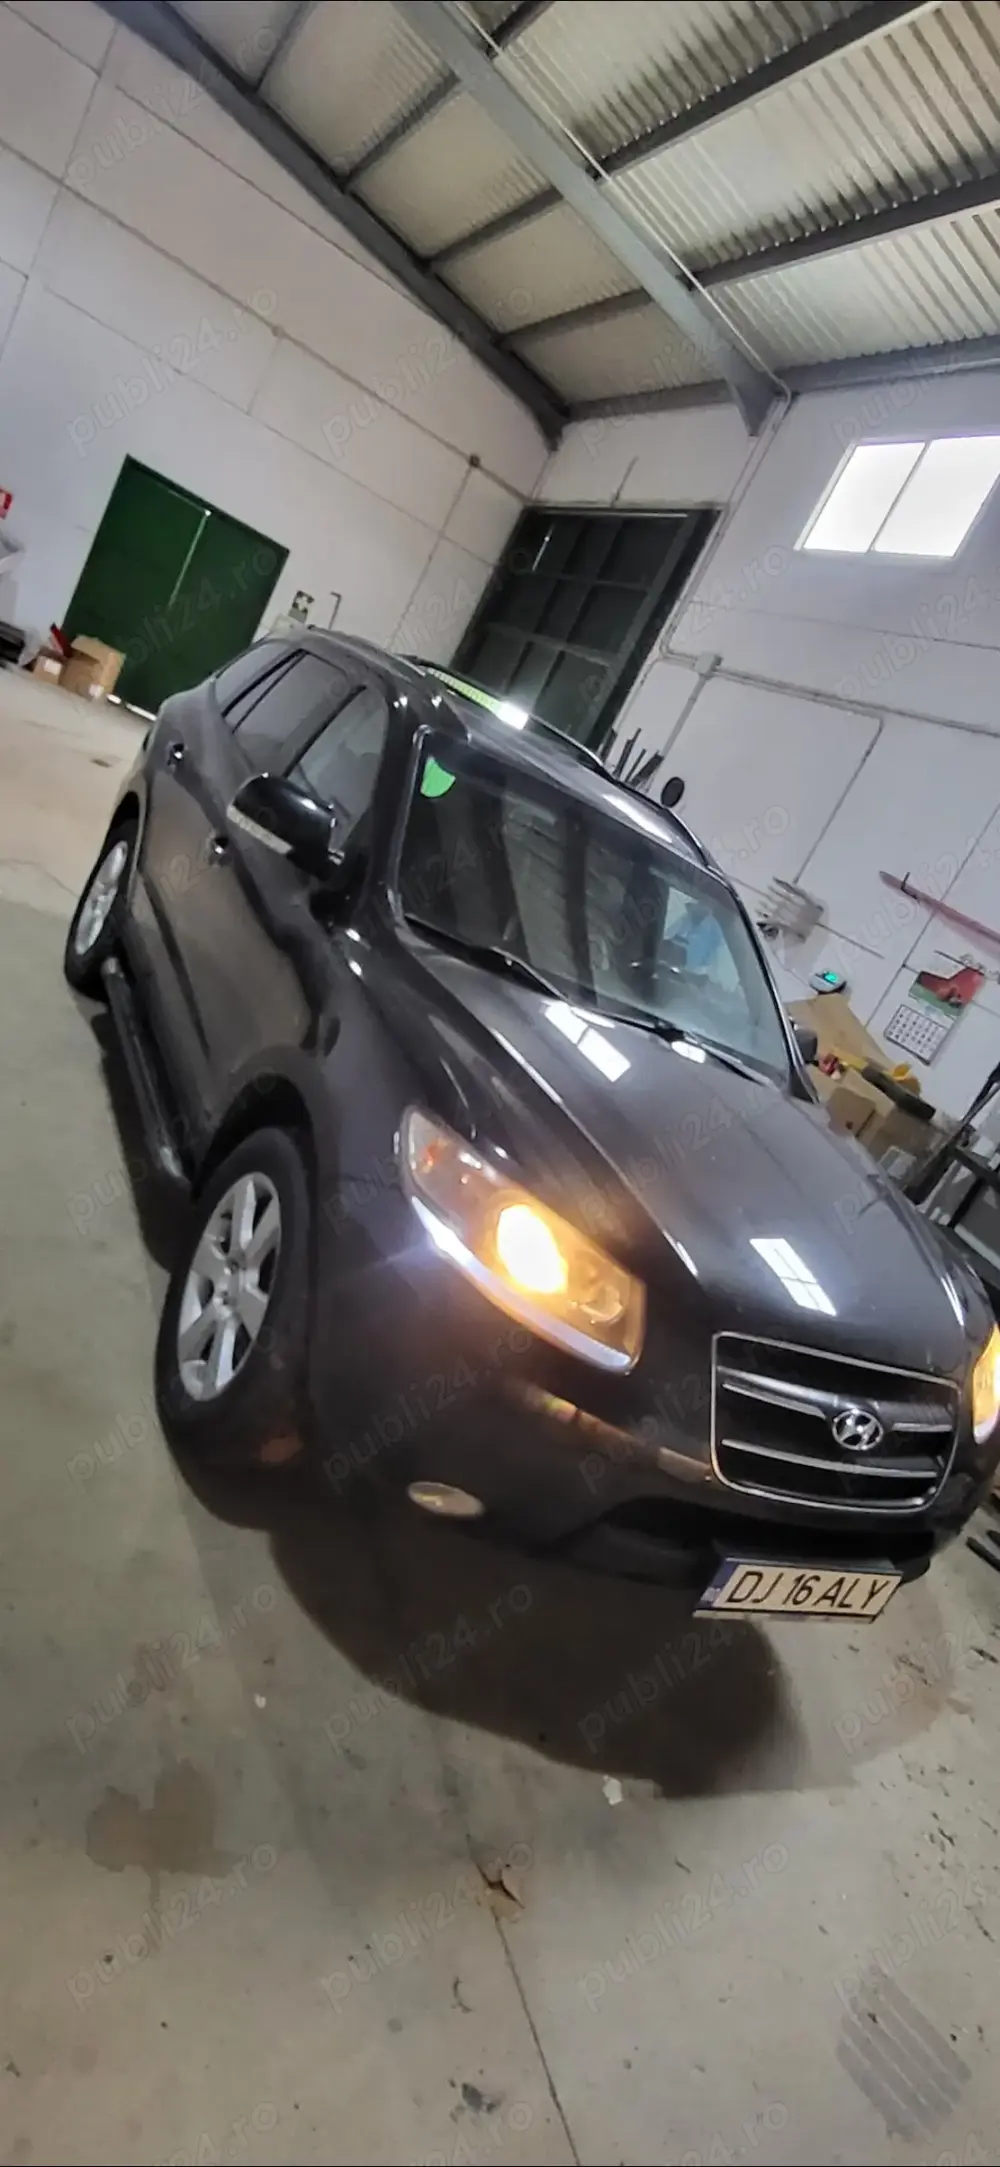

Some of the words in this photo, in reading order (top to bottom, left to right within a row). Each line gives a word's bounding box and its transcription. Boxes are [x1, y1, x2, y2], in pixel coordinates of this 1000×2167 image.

[725, 1571, 784, 1603] DJ
[782, 1573, 820, 1605] 16
[813, 1577, 891, 1612] ALY
